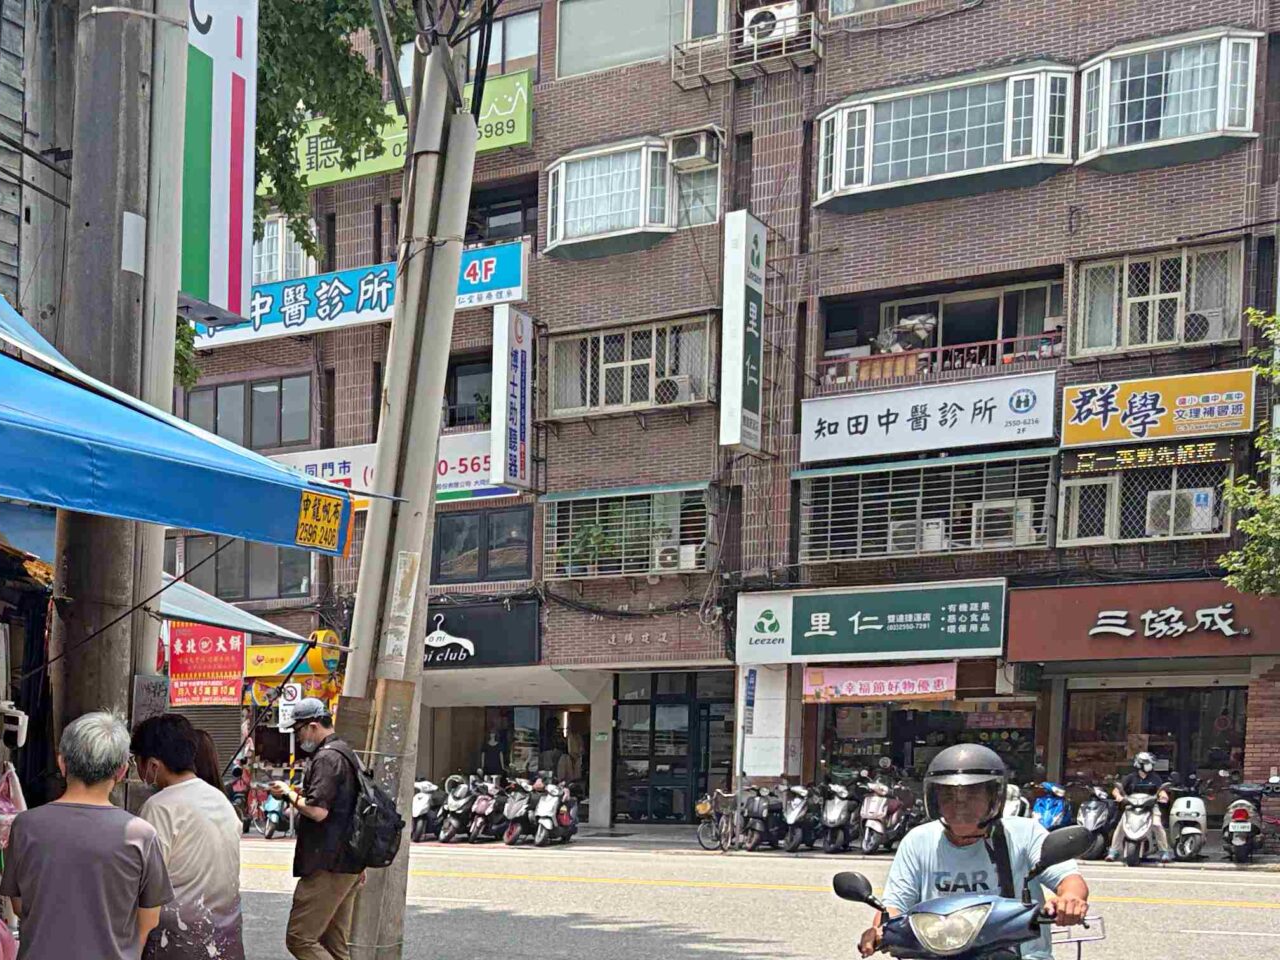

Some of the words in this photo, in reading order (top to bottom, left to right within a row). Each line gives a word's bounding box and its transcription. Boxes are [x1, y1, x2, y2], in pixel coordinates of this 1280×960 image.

[464, 258, 496, 283] 4F
[1070, 384, 1166, 437] 群學
[1174, 404, 1244, 420] 文理補習班
[295, 459, 351, 478] 同門市
[804, 611, 883, 638] 里仁
[1088, 603, 1241, 638] 三協成
[748, 636, 785, 645] Leezen
[436, 648, 467, 661] club
[845, 677, 946, 695] 幸福節好物優惠
